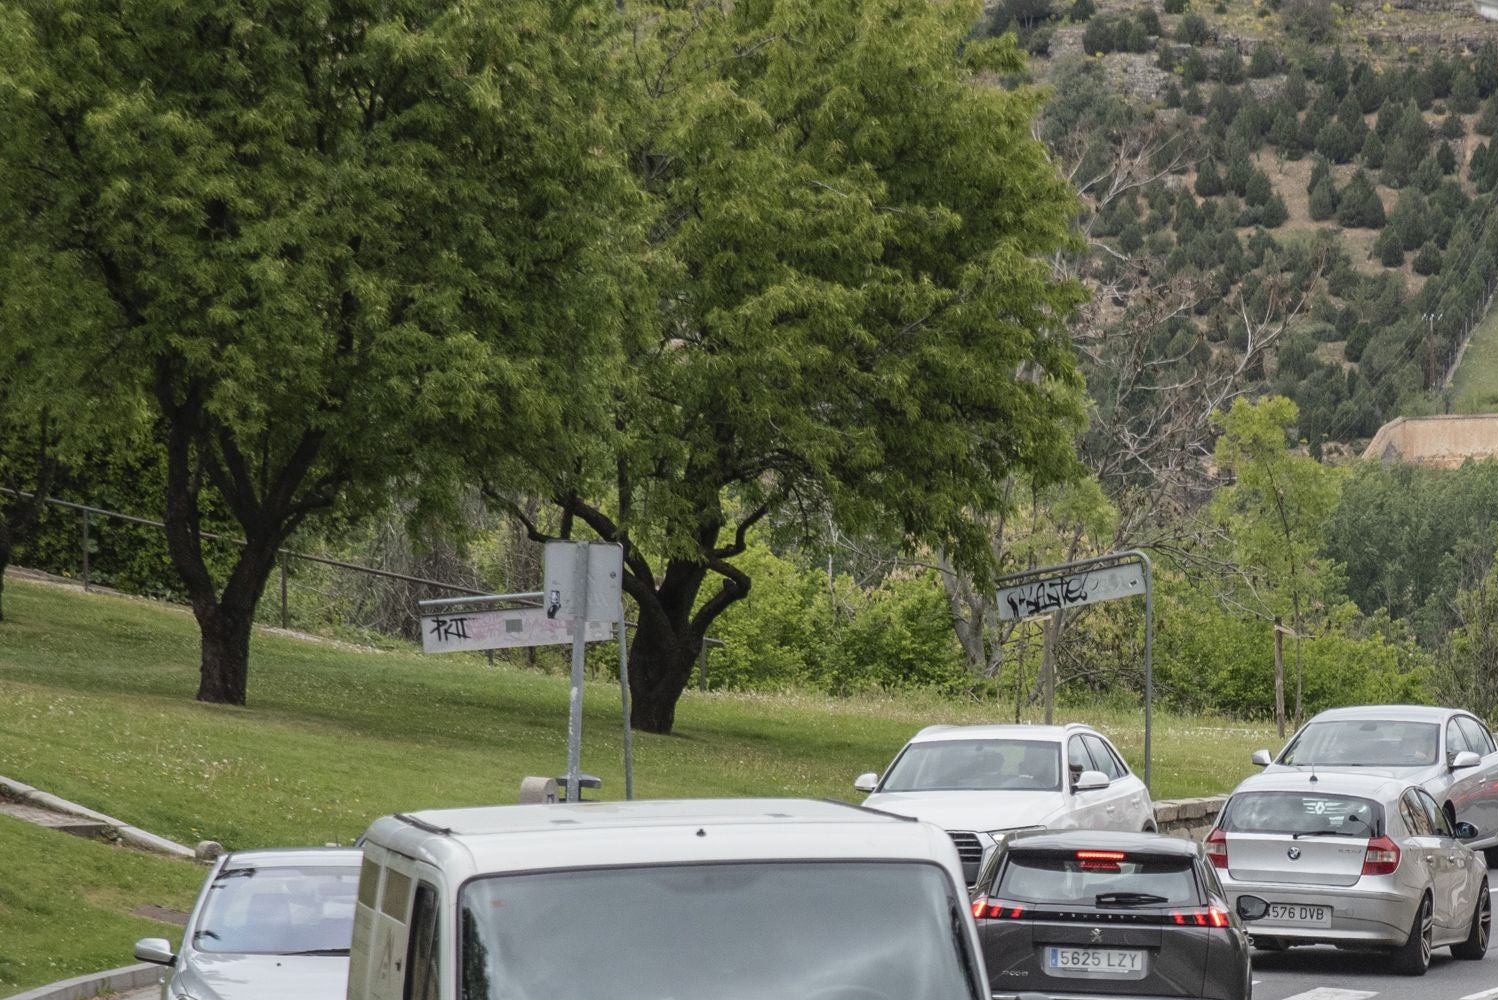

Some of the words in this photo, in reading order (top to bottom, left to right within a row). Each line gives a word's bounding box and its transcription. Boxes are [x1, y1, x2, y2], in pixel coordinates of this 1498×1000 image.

[1267, 906, 1296, 919] 576
[1300, 907, 1324, 920] DVB
[1060, 951, 1101, 967] 5625
[1107, 952, 1138, 968] LZY
